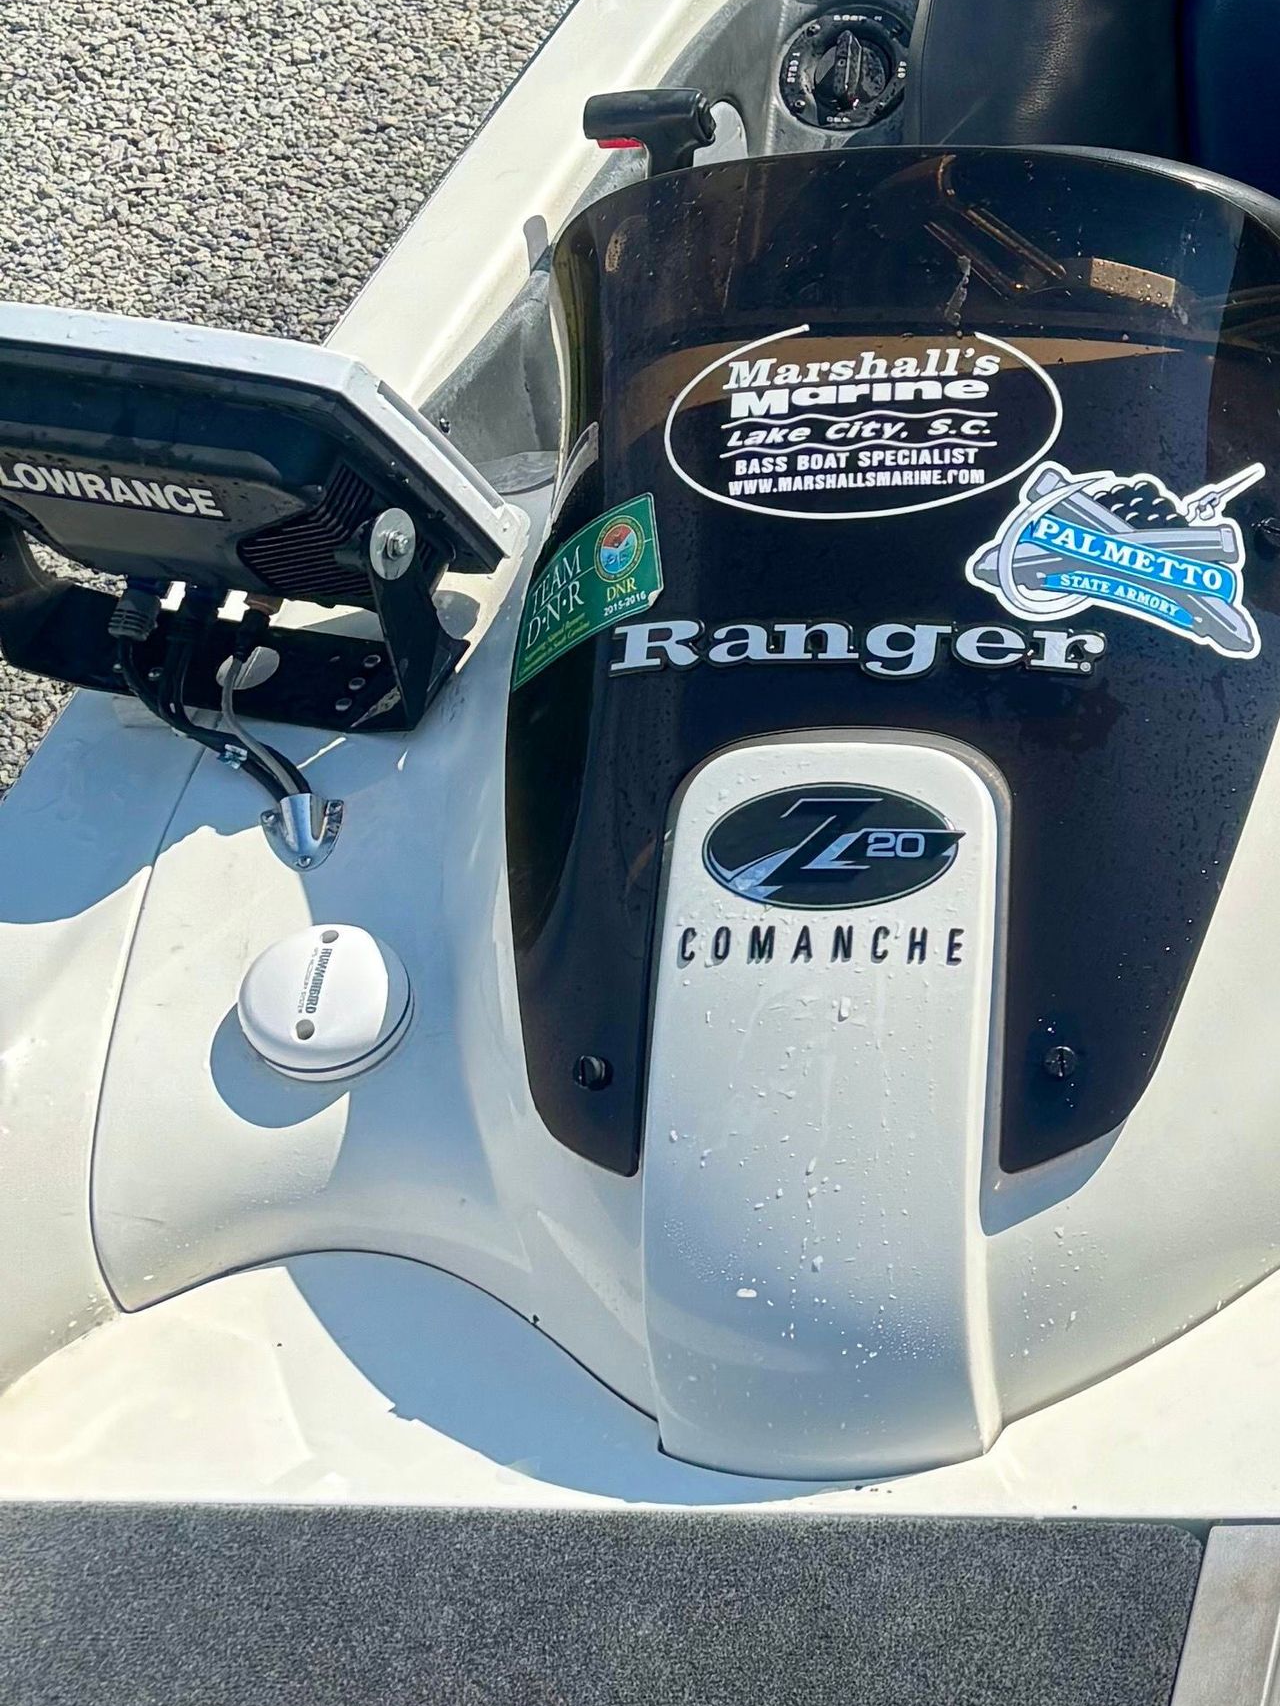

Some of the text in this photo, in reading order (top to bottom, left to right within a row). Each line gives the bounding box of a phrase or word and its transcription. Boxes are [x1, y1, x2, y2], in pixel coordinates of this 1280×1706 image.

[722, 348, 1001, 390] Marshall's
[730, 379, 990, 418] Marine
[727, 419, 991, 447] Lake City, S.C.
[735, 448, 978, 476] BASS BOAT SPECIALIST
[1034, 518, 1224, 591] PALMETTO
[532, 545, 582, 615] TEAM
[606, 577, 638, 603] DNR
[1060, 574, 1180, 617] STATE ARMORY
[603, 590, 647, 617] 2015-2016
[609, 620, 1106, 676] Ranger
[677, 925, 965, 969] COMANCHE
